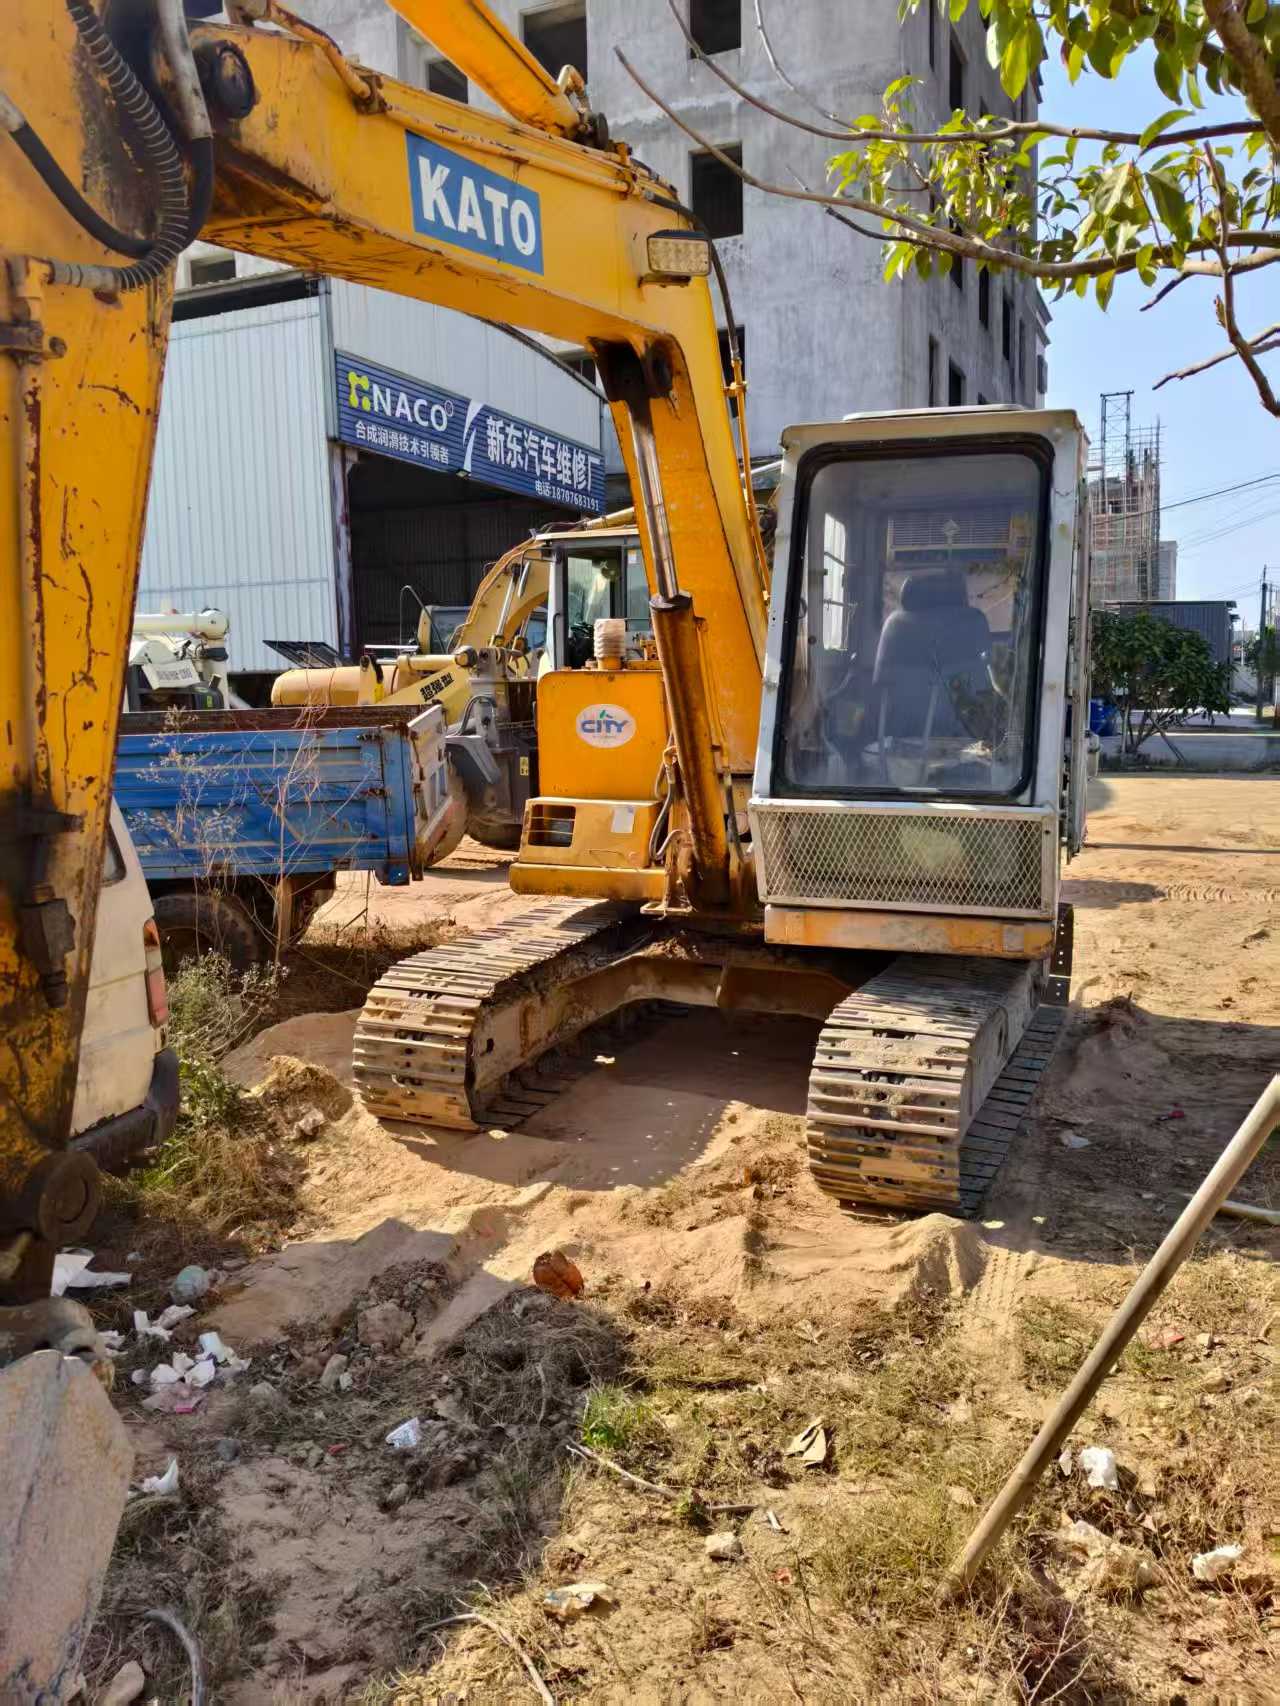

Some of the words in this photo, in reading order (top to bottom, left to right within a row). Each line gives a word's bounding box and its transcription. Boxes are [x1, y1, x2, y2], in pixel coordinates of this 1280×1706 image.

[418, 155, 536, 256] KATO
[372, 384, 448, 432] NACO
[355, 420, 449, 465] 合成润滑技术引领者
[486, 416, 600, 492] 新东汽车维修厂
